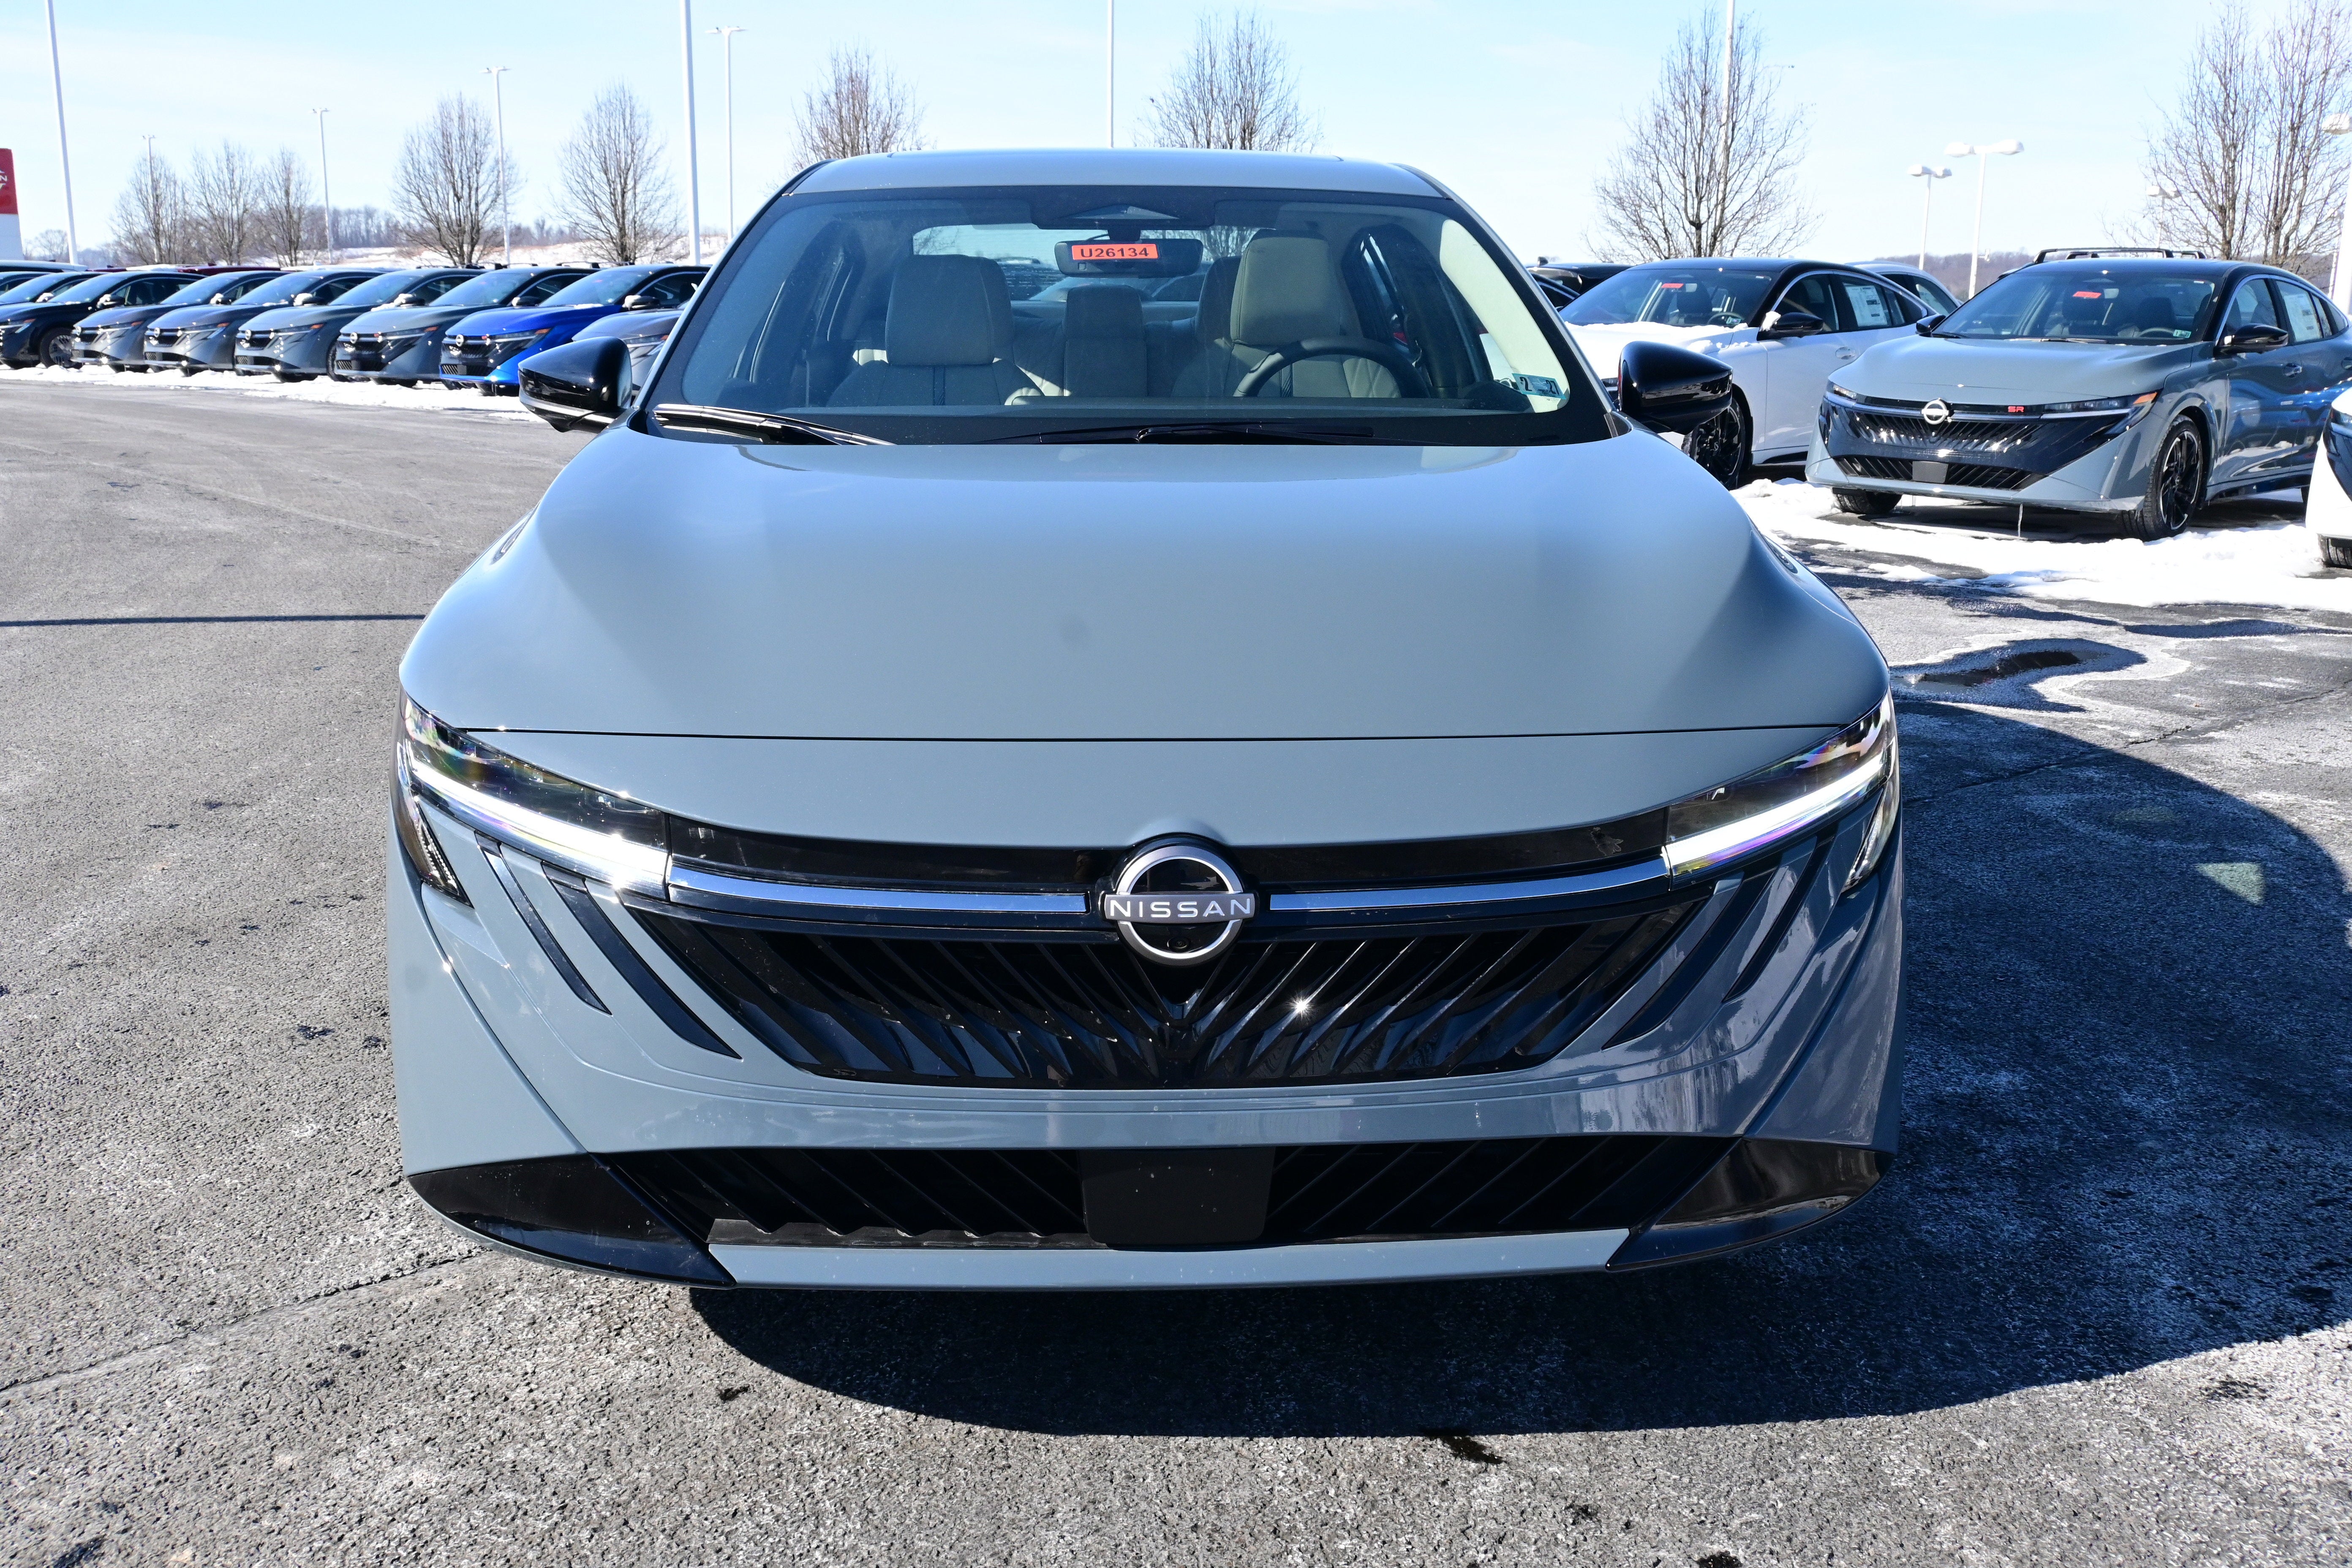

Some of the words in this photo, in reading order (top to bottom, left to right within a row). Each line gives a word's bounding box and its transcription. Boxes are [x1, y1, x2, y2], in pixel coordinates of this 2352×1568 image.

[1081, 248, 1149, 258] U26134
[1519, 376, 1532, 391] 2
[1545, 380, 1560, 395] 27
[1110, 898, 1250, 917] NISSAN
